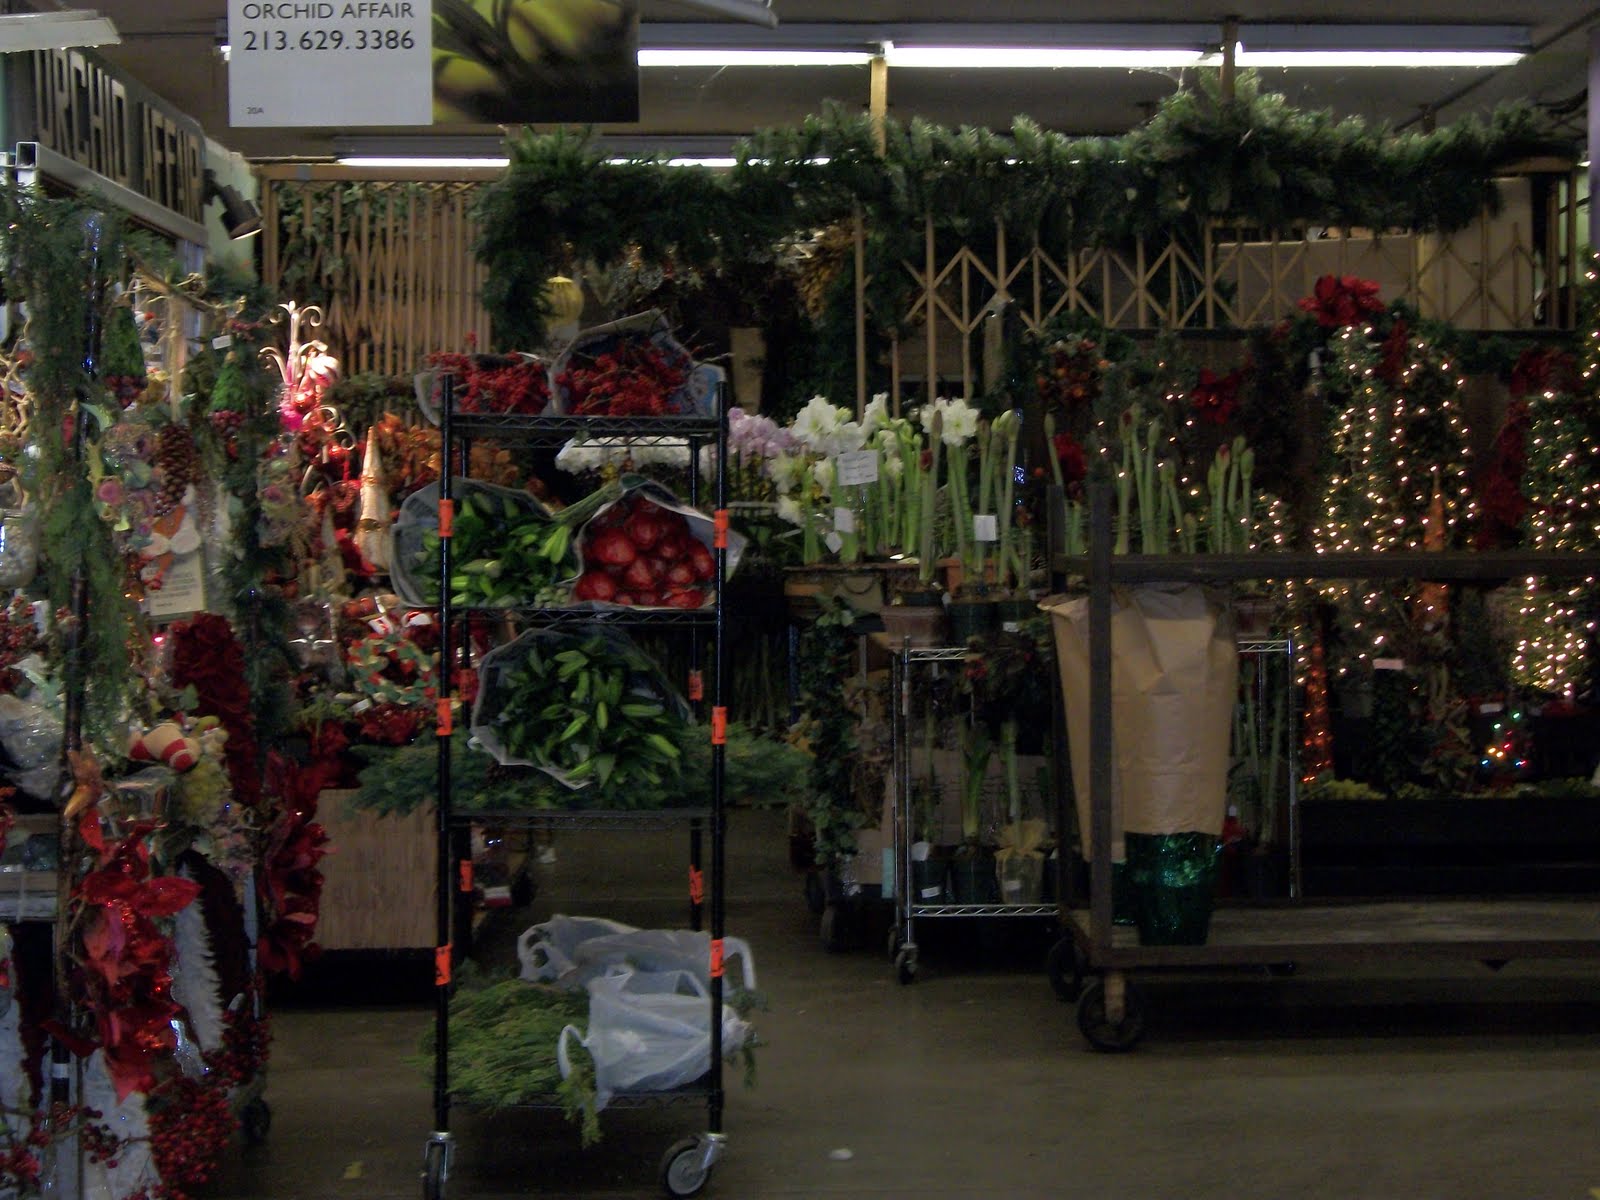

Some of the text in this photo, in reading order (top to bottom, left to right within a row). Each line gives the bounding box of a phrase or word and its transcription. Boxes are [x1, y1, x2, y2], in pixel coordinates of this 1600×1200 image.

[243, 2, 415, 20] ORCHID AFFAIR
[243, 30, 415, 51] 213.629.3386
